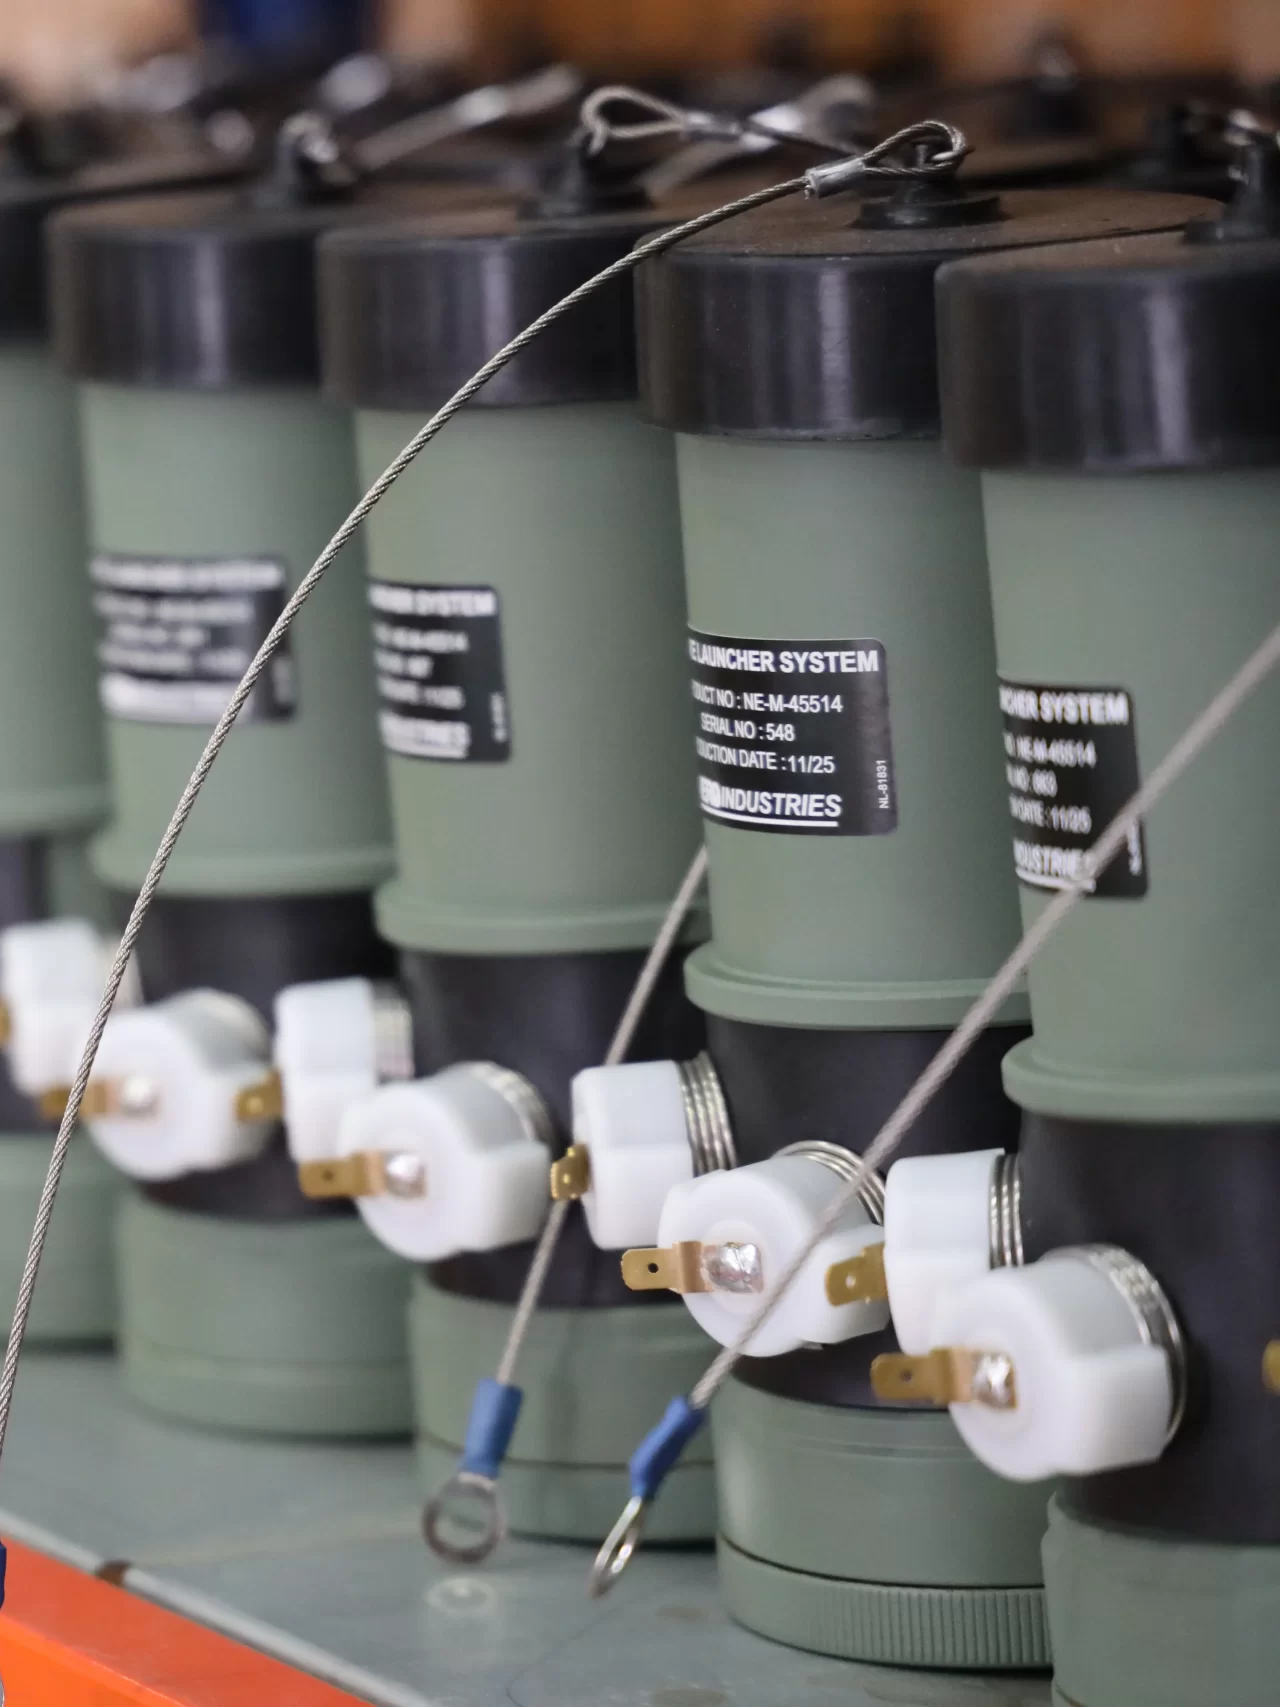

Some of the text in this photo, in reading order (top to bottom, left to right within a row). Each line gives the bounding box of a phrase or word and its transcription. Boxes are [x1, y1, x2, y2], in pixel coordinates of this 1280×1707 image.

[696, 642, 776, 673] LAUNCHER
[779, 650, 879, 673] SYSTEM
[715, 688, 734, 708] NO
[743, 692, 843, 713] NE-M-45514
[1039, 690, 1129, 725] SYSTEM
[701, 712, 734, 737] SERIAL
[734, 719, 756, 739] NO
[766, 723, 795, 741] 548
[738, 748, 778, 771] DATE
[788, 755, 835, 774] 11/25
[720, 786, 842, 818] INDUSTRIES
